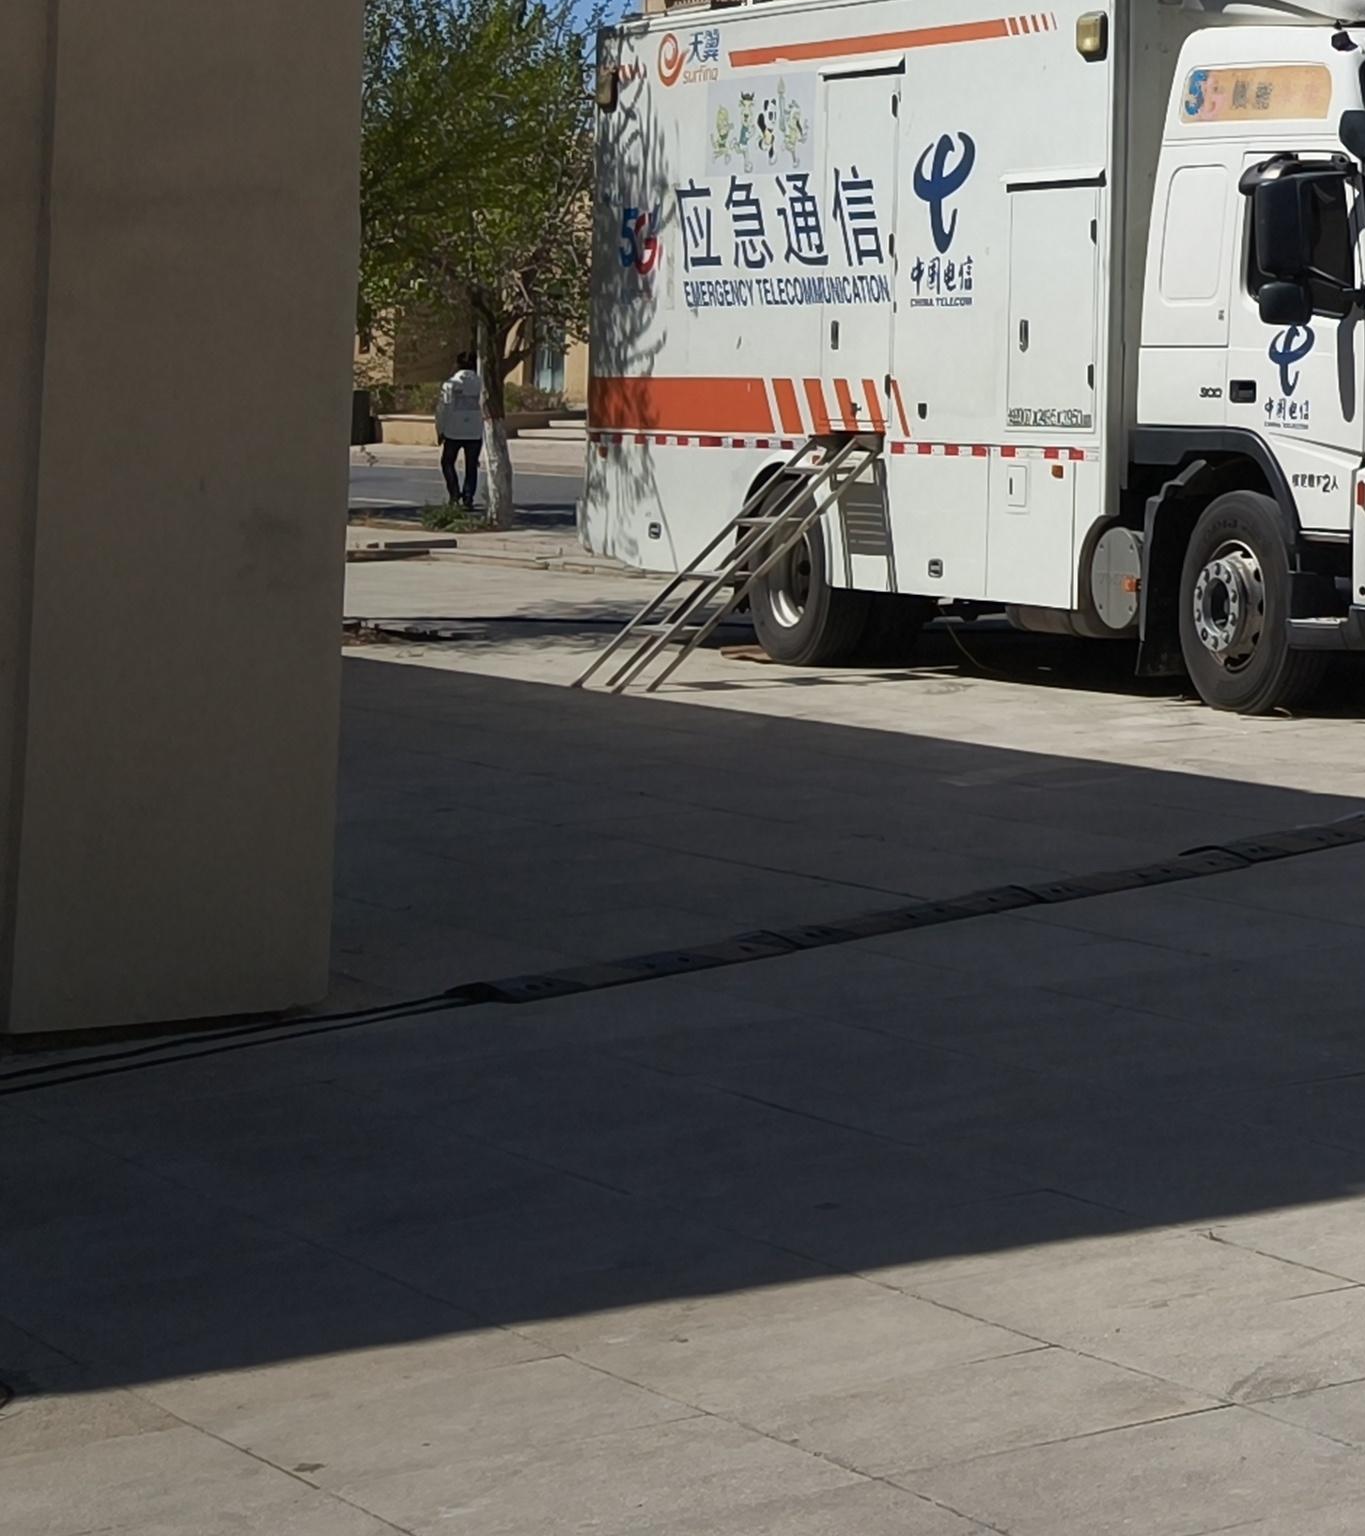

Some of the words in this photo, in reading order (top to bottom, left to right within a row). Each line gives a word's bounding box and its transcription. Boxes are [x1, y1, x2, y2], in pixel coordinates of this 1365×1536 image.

[687, 28, 720, 64] 天翼
[675, 164, 885, 274] 应急通信
[683, 277, 754, 308] EMERGENCY
[755, 274, 892, 307] TELECOMMUNICATION
[910, 255, 974, 296] 中国电信
[1264, 397, 1310, 421] 中国电信
